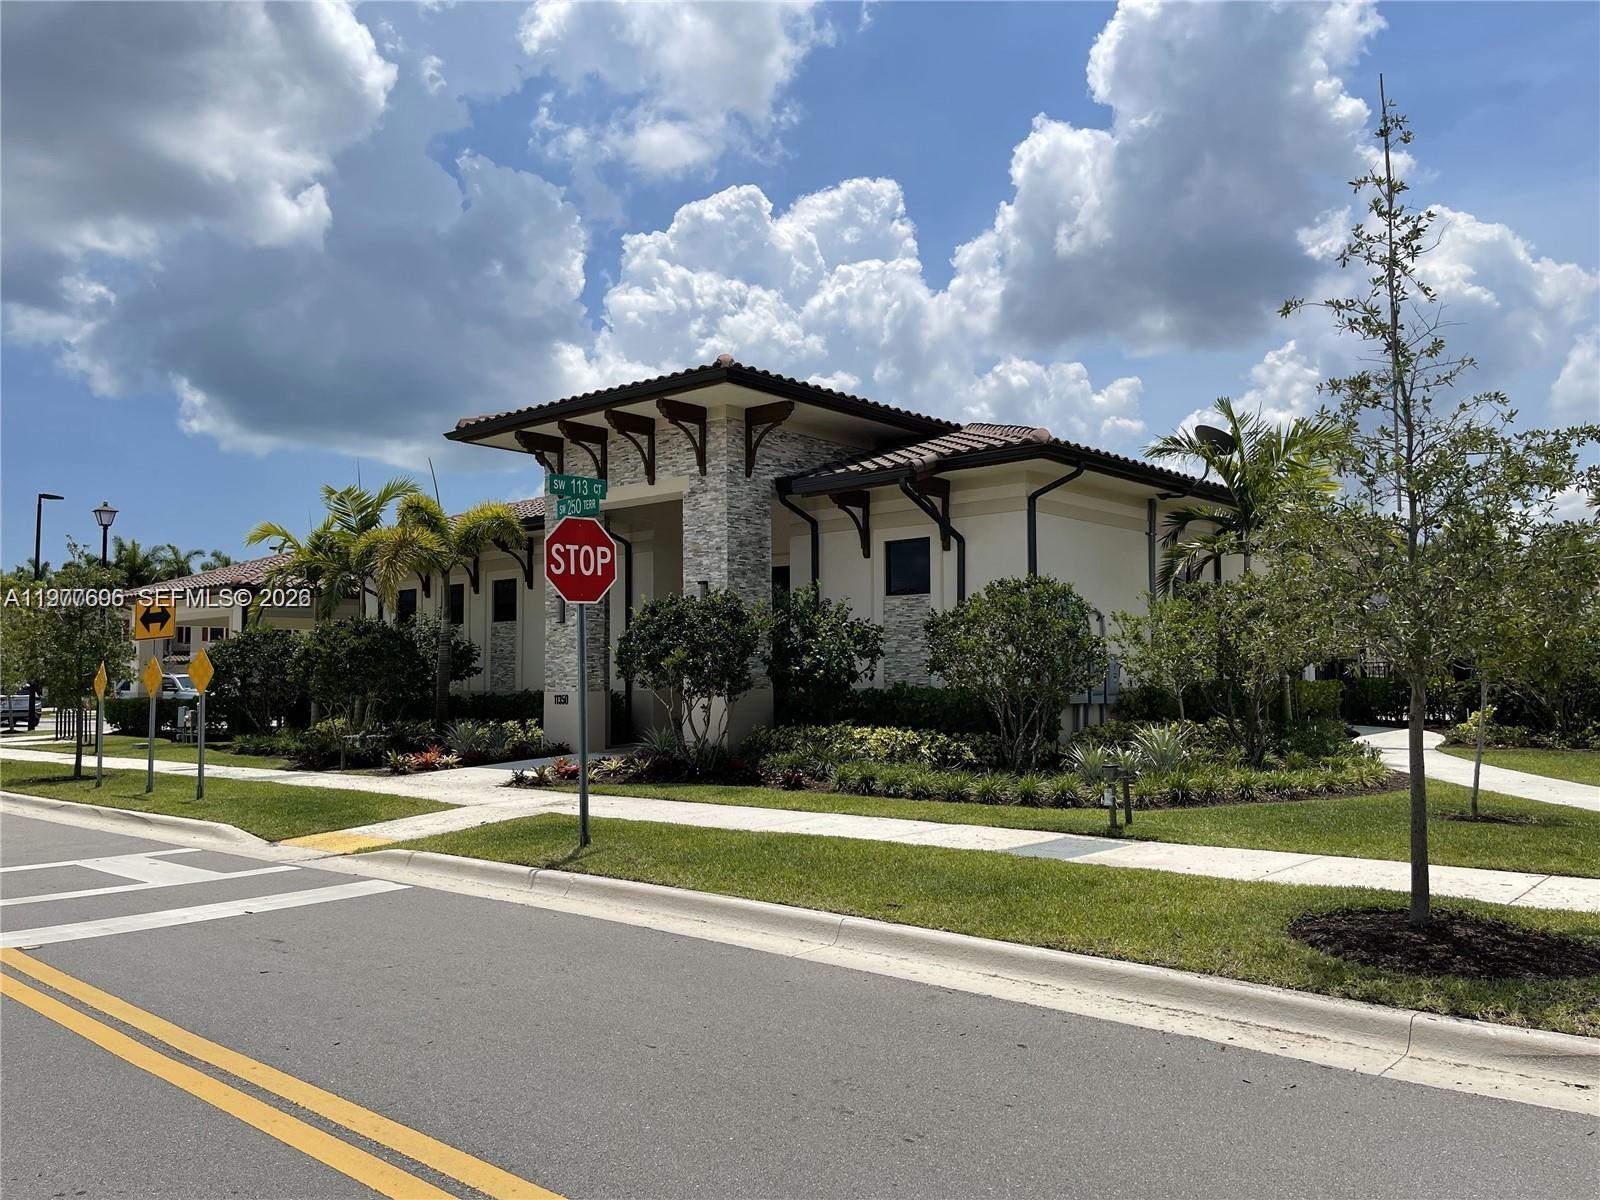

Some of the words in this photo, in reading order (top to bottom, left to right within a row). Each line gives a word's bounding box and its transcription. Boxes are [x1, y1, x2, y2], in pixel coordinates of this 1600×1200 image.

[553, 479, 566, 490] SW
[571, 478, 588, 496] 113
[593, 484, 602, 495] CT
[567, 498, 582, 515] 250
[583, 499, 596, 510] TERR
[550, 543, 612, 576] STOP
[554, 694, 569, 705] 11350
